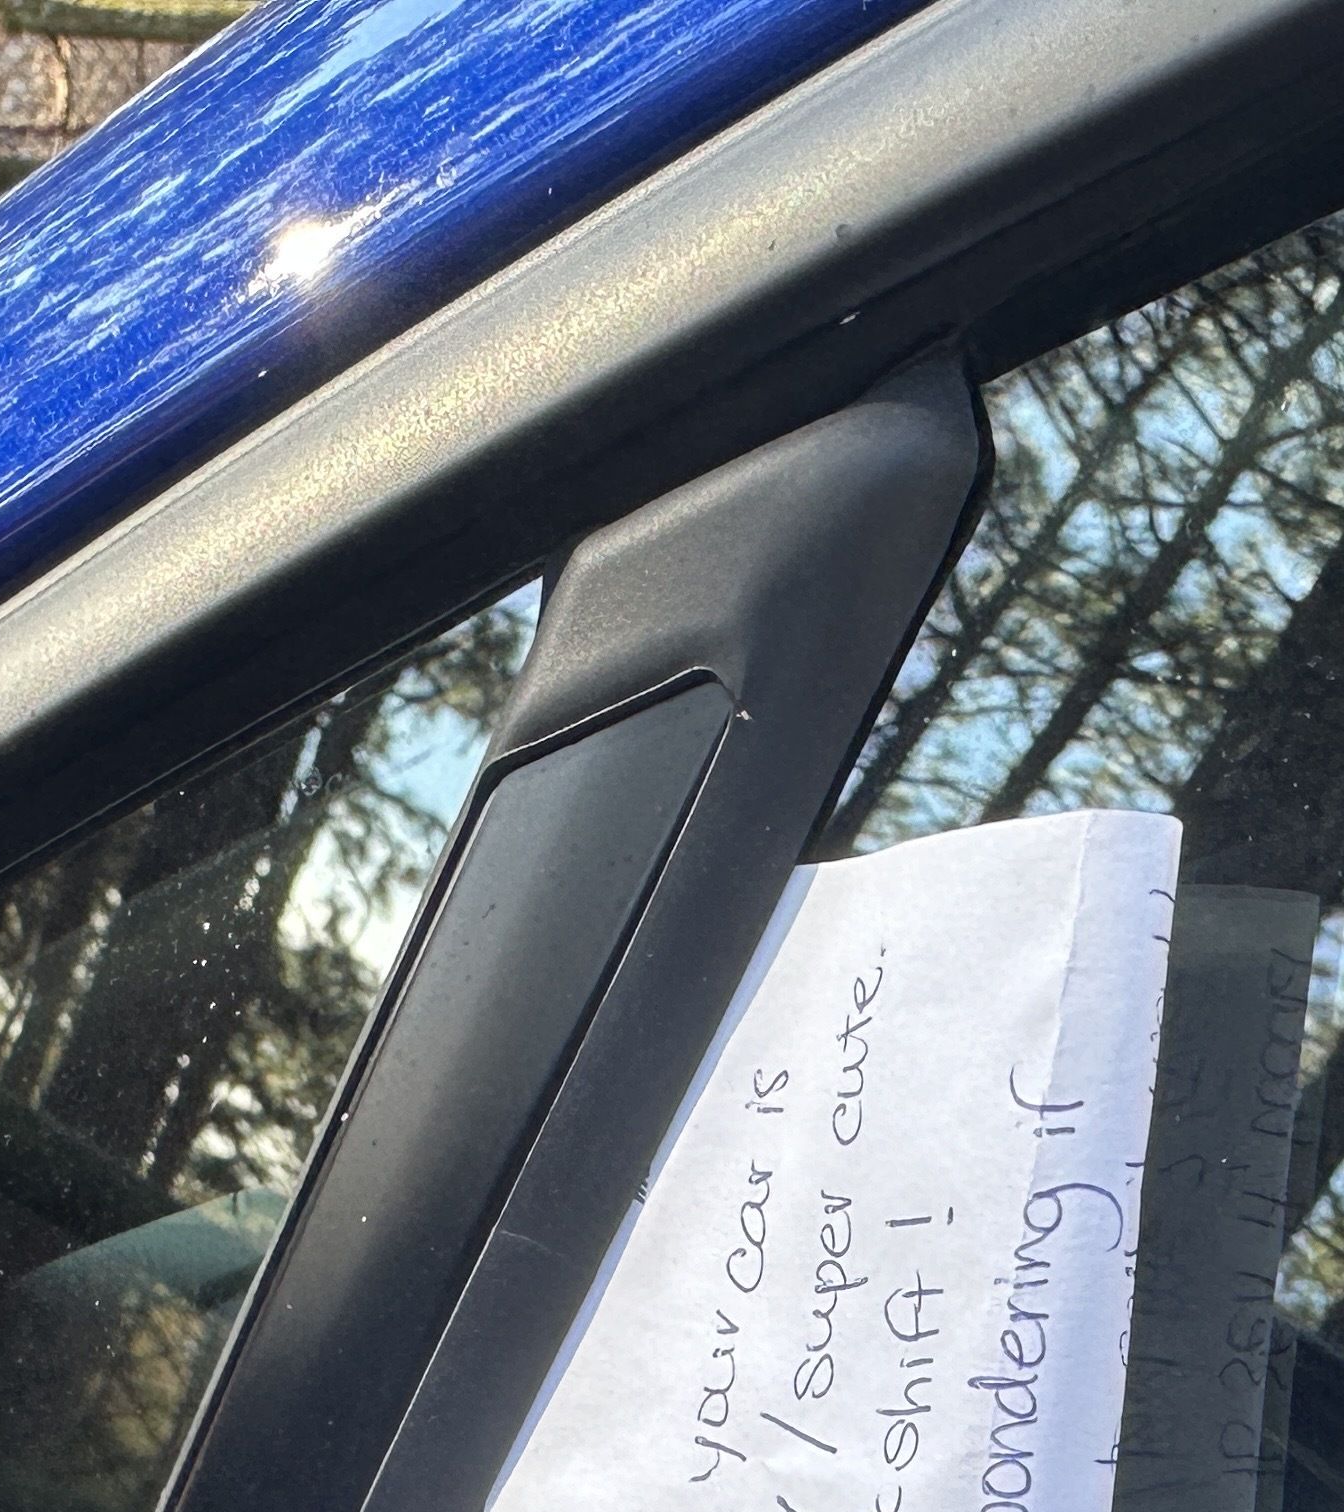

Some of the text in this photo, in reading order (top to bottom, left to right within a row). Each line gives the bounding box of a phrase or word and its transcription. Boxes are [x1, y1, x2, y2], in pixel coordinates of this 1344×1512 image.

[745, 1069, 789, 1113] is
[832, 943, 887, 1145] cute.
[1010, 1064, 1084, 1138] if
[726, 1160, 773, 1293] car
[689, 1310, 747, 1482] your
